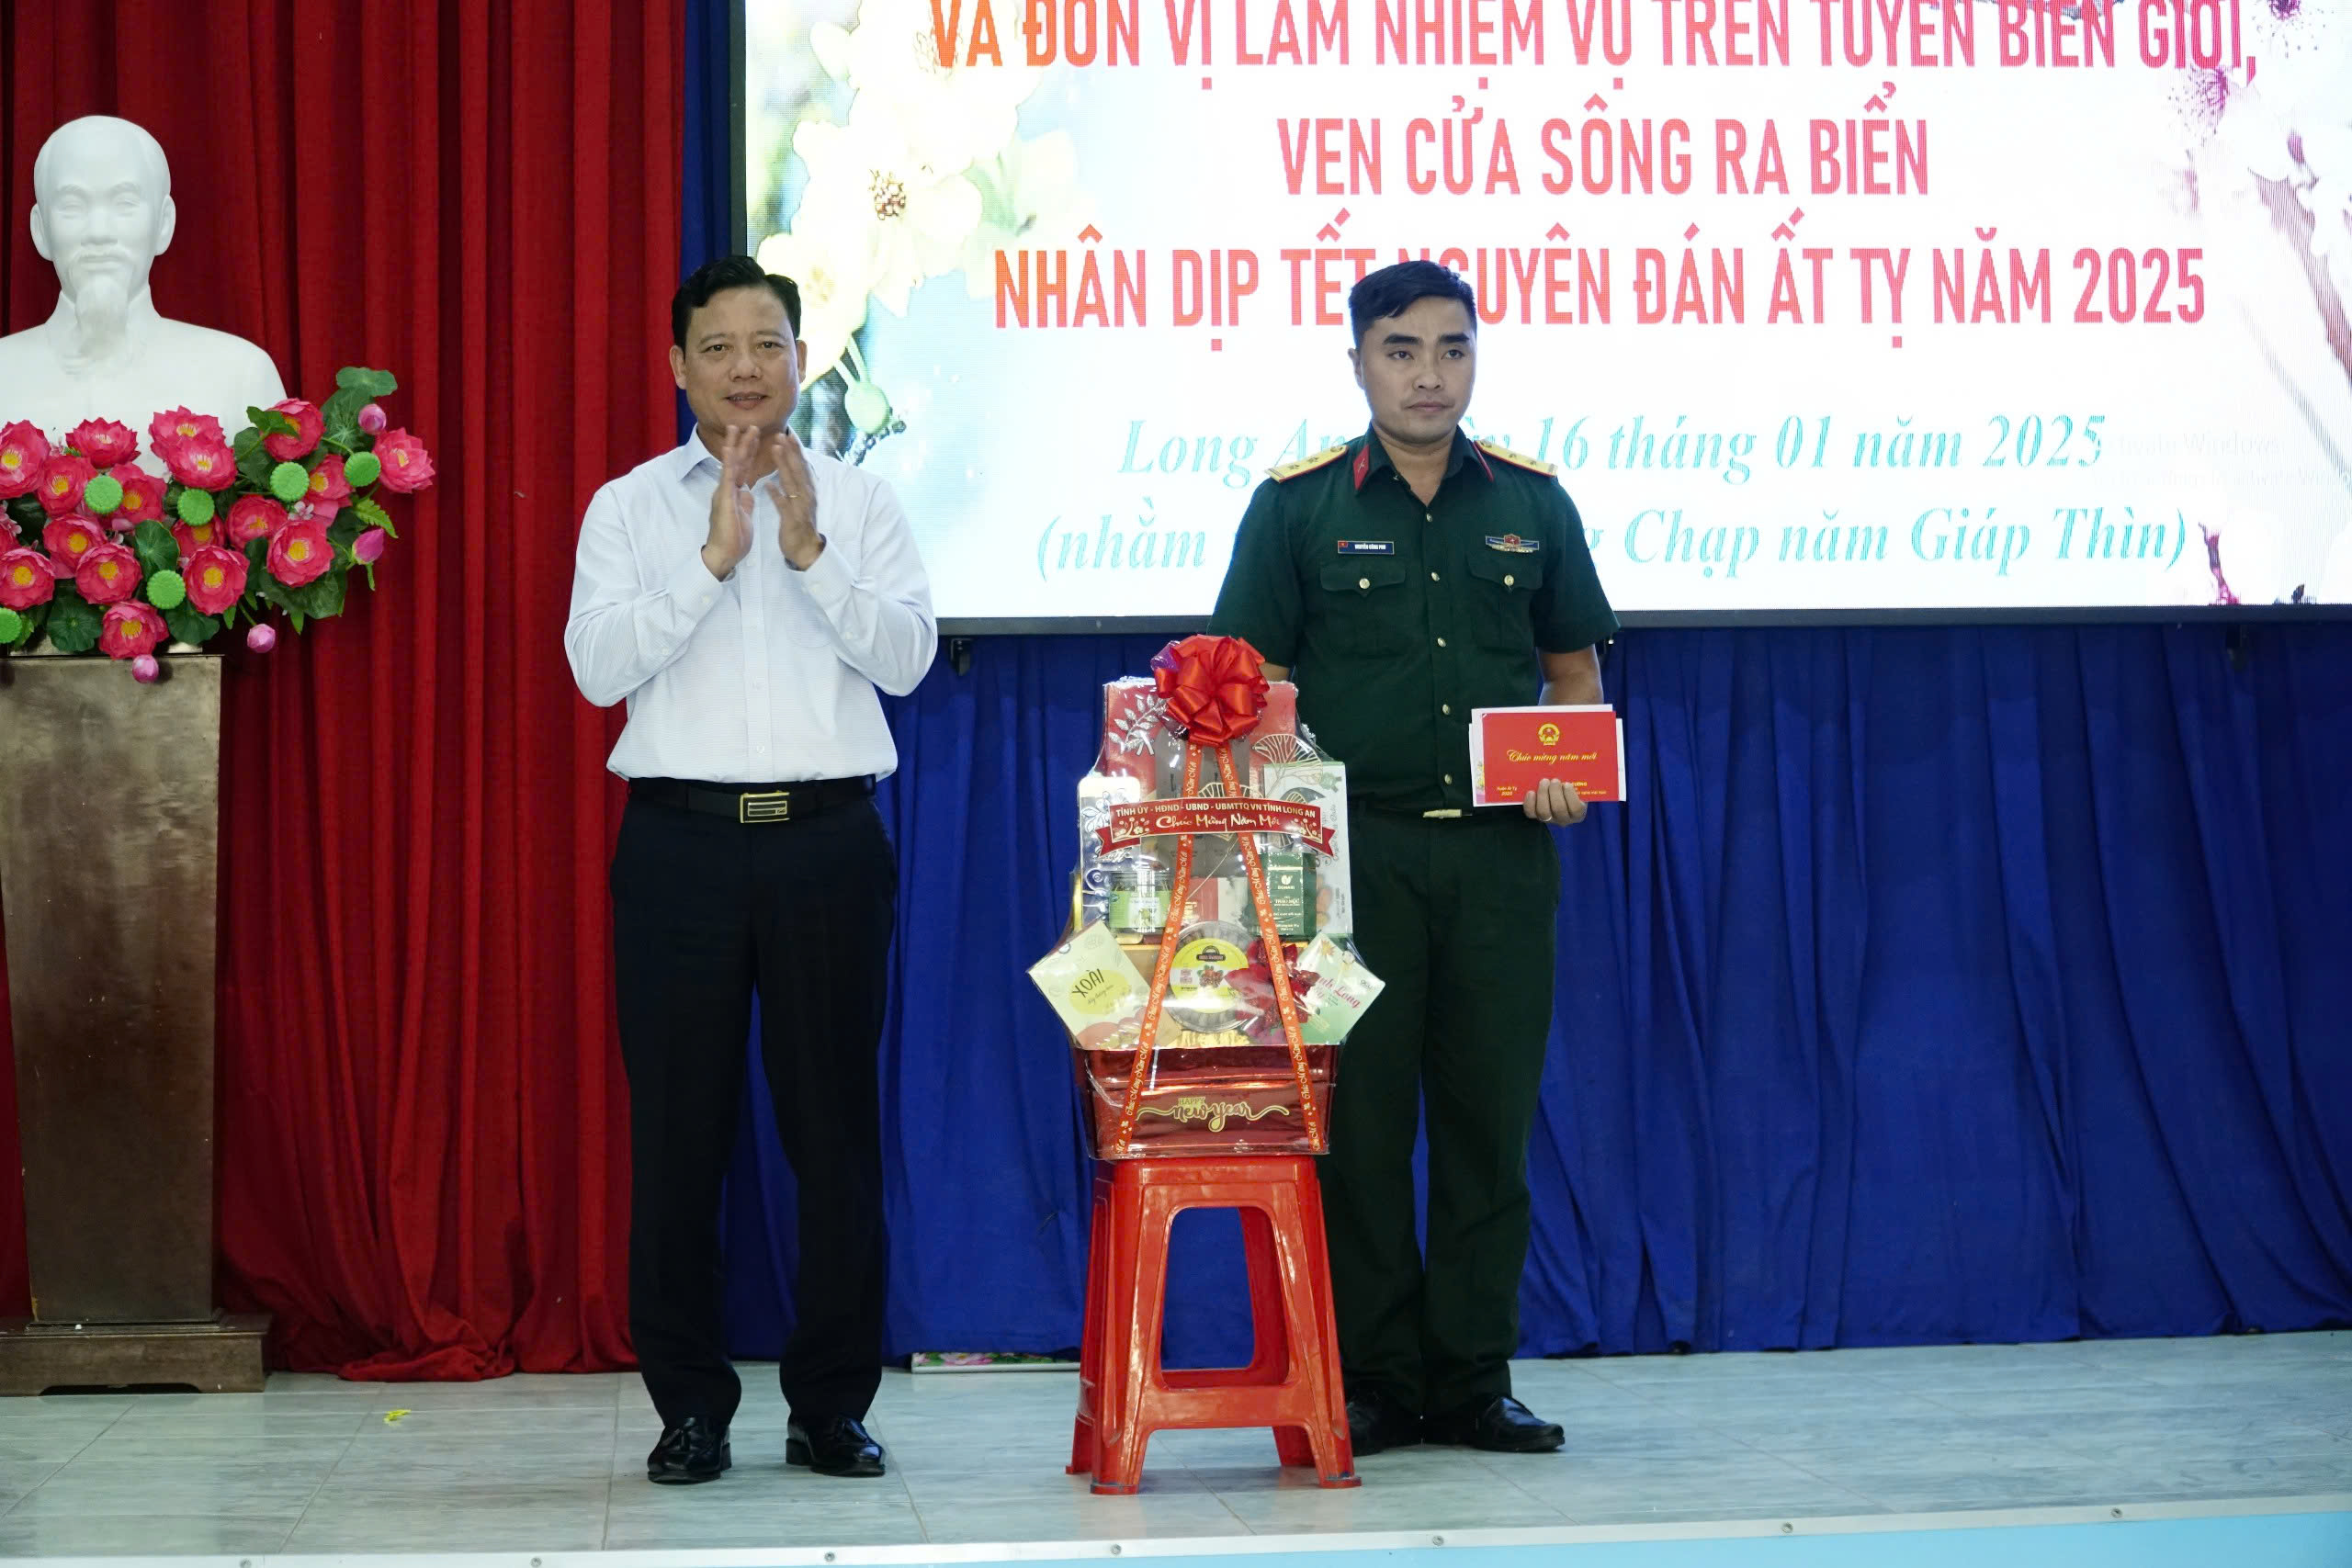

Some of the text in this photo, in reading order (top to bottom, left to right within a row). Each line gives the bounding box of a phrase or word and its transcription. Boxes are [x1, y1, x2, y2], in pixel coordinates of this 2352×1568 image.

[1164, 0, 1212, 90] VỊ
[1566, 0, 1632, 90] VỤ
[1277, 81, 1928, 195] VEN CỬA SÔNG RA BIỂN
[995, 207, 2205, 351] NHÂN DỊP TẾT UYÊN ĐÁN ẤT TỴ NĂM 2025
[1117, 419, 1258, 489] Long
[1537, 415, 1590, 470] 16
[1608, 414, 1757, 485] tháng
[1777, 414, 1831, 468] 01
[1853, 414, 1962, 468] năm
[1983, 414, 2106, 467] 2025
[1037, 495, 1206, 581] (nhằm
[1624, 506, 2186, 579] Chạp năm Giáp Thìn)
[1507, 749, 1532, 762] Chúc
[1560, 752, 1579, 761] năm
[1115, 806, 1136, 818] TỈNH
[1155, 804, 1180, 814] HĐND
[1185, 803, 1209, 811] UBND
[1215, 802, 1250, 811] UBMTTQ
[1250, 803, 1262, 811] VN
[1283, 807, 1304, 817] LONG
[1305, 809, 1316, 818] AN
[1156, 812, 1280, 832] Chúc Mừng Năm Mới
[1071, 968, 1105, 998] XOÀI
[1173, 1104, 1209, 1122] new
[1179, 1097, 1205, 1105] HAPPY
